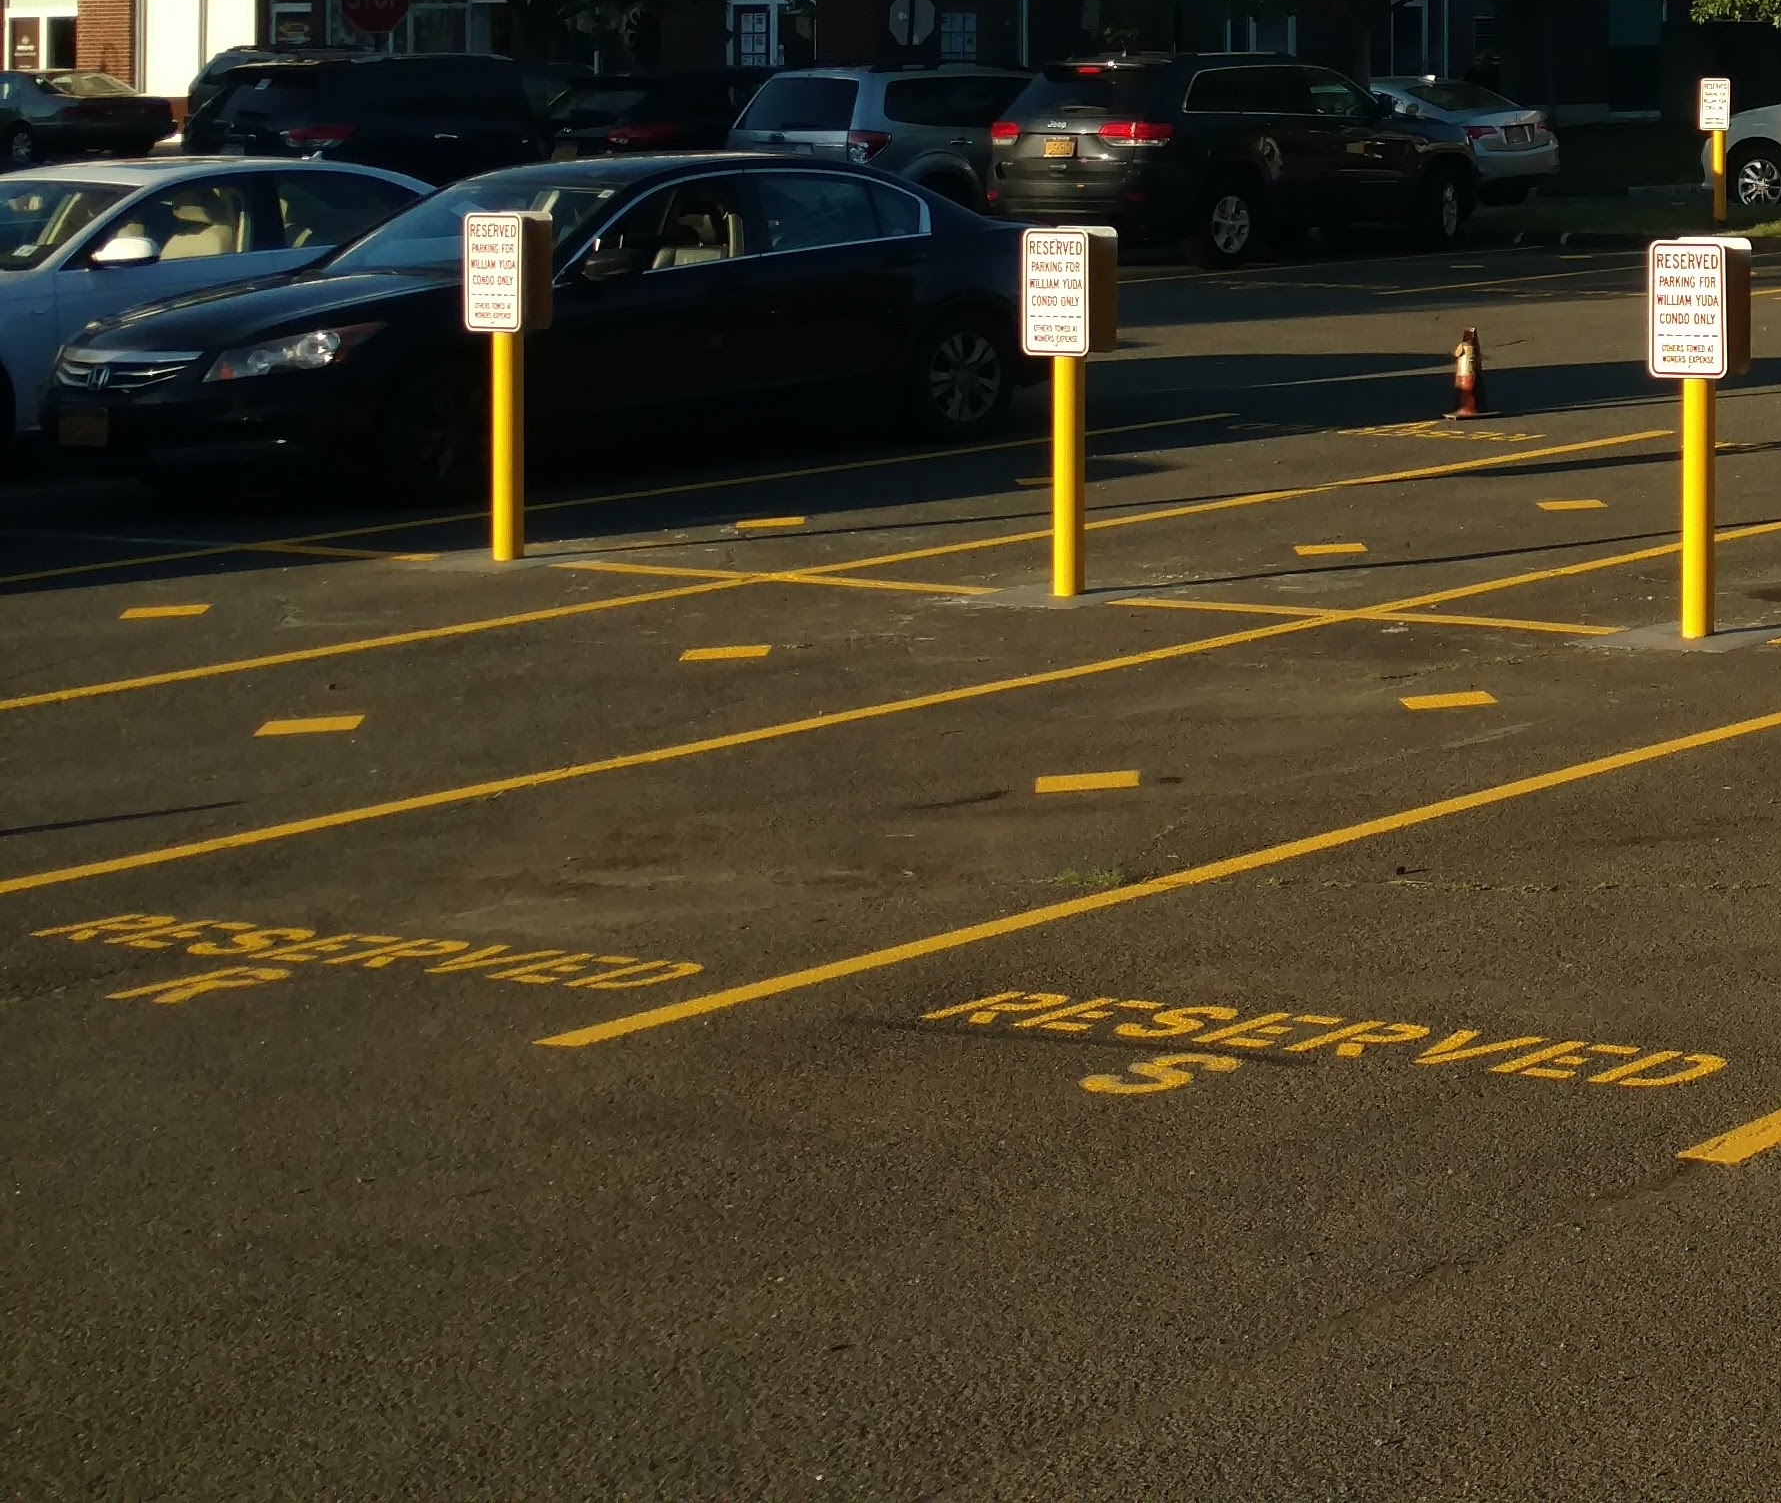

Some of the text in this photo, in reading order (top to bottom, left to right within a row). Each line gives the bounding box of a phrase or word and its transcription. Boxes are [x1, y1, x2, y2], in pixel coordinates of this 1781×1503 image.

[469, 223, 517, 238] RESERVED
[471, 243, 515, 254] PARKING FOR
[1029, 240, 1083, 256] RESERVED
[470, 259, 517, 270] WILLIAM YUDA
[1030, 261, 1081, 273] PARKING FOR
[1656, 253, 1719, 270] RESERVED
[472, 274, 515, 286] CONDO ONLY
[1029, 278, 1083, 290] WILLIAM YUDA
[1658, 275, 1716, 289] PARKING FOR
[1031, 295, 1080, 307] CONDO ONLY
[1656, 294, 1692, 307] WILLIAM
[1695, 294, 1719, 307] YUDA
[1659, 312, 1716, 325] CONDO ONLY
[1661, 344, 1714, 353] OTHERS TOWED AT
[36, 914, 704, 989] RESERVED
[112, 966, 290, 1004] R
[923, 991, 1729, 1088] RESERVED
[1080, 1053, 1242, 1096] S
